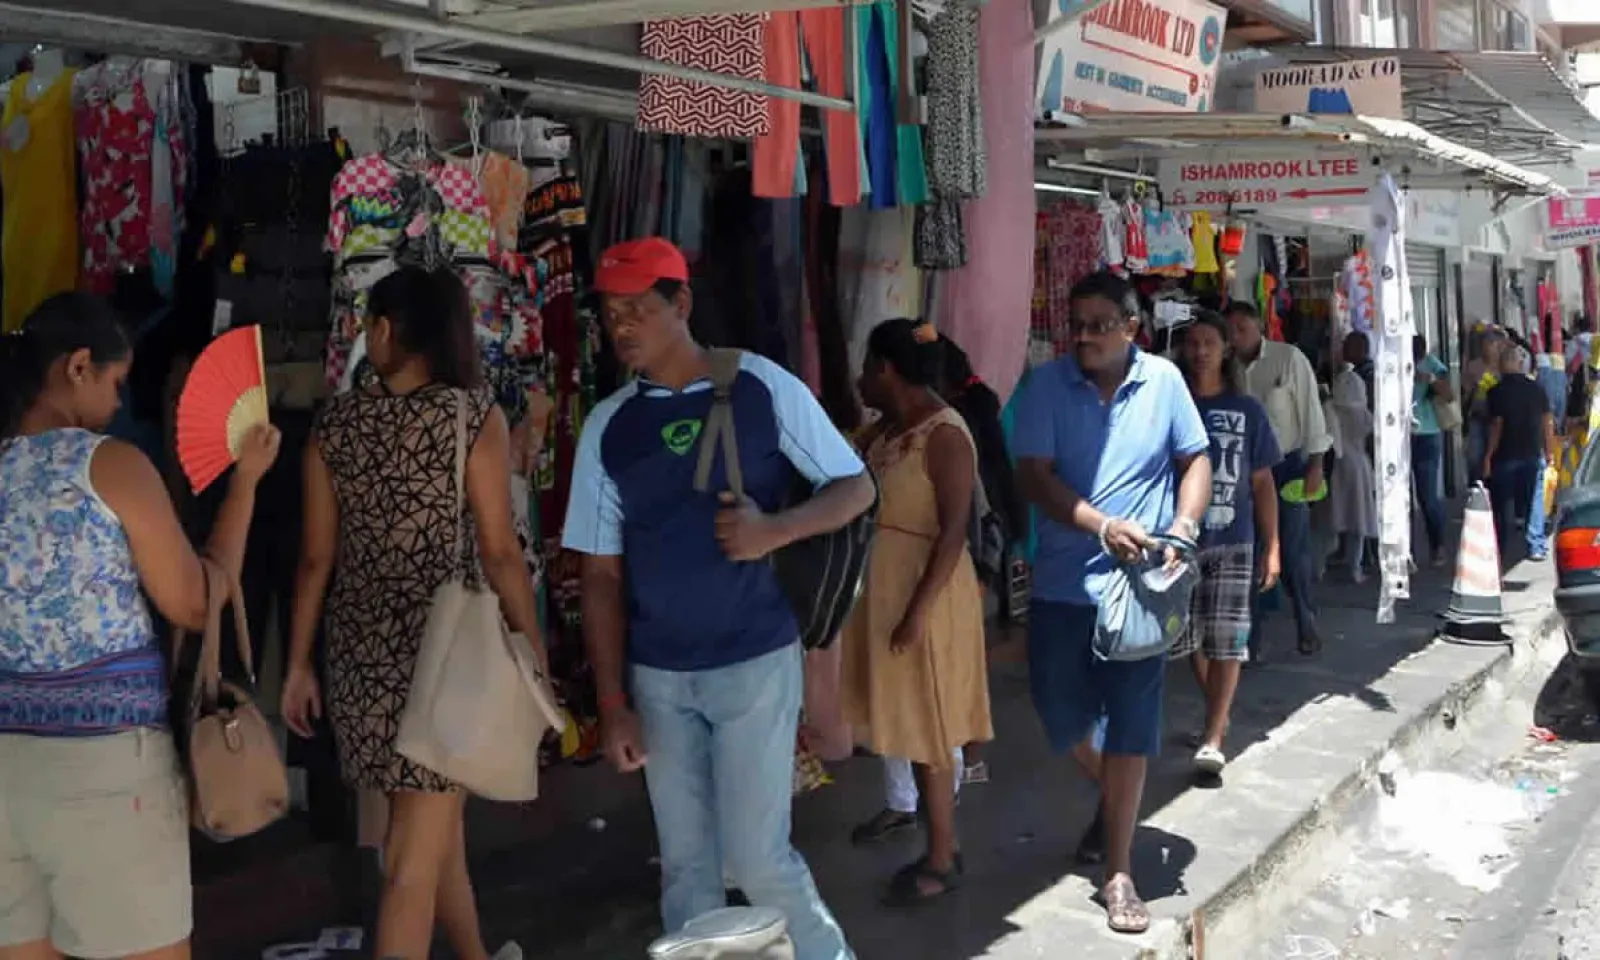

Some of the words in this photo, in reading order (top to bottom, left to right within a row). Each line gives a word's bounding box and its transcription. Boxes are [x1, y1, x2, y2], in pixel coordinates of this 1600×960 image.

[1172, 16, 1196, 57] LTD
[1261, 65, 1344, 88] MOORAD
[1348, 64, 1365, 80] &
[1370, 60, 1396, 77] CO
[1181, 162, 1302, 182] ISHAMROOK
[1307, 158, 1359, 177] LTEE
